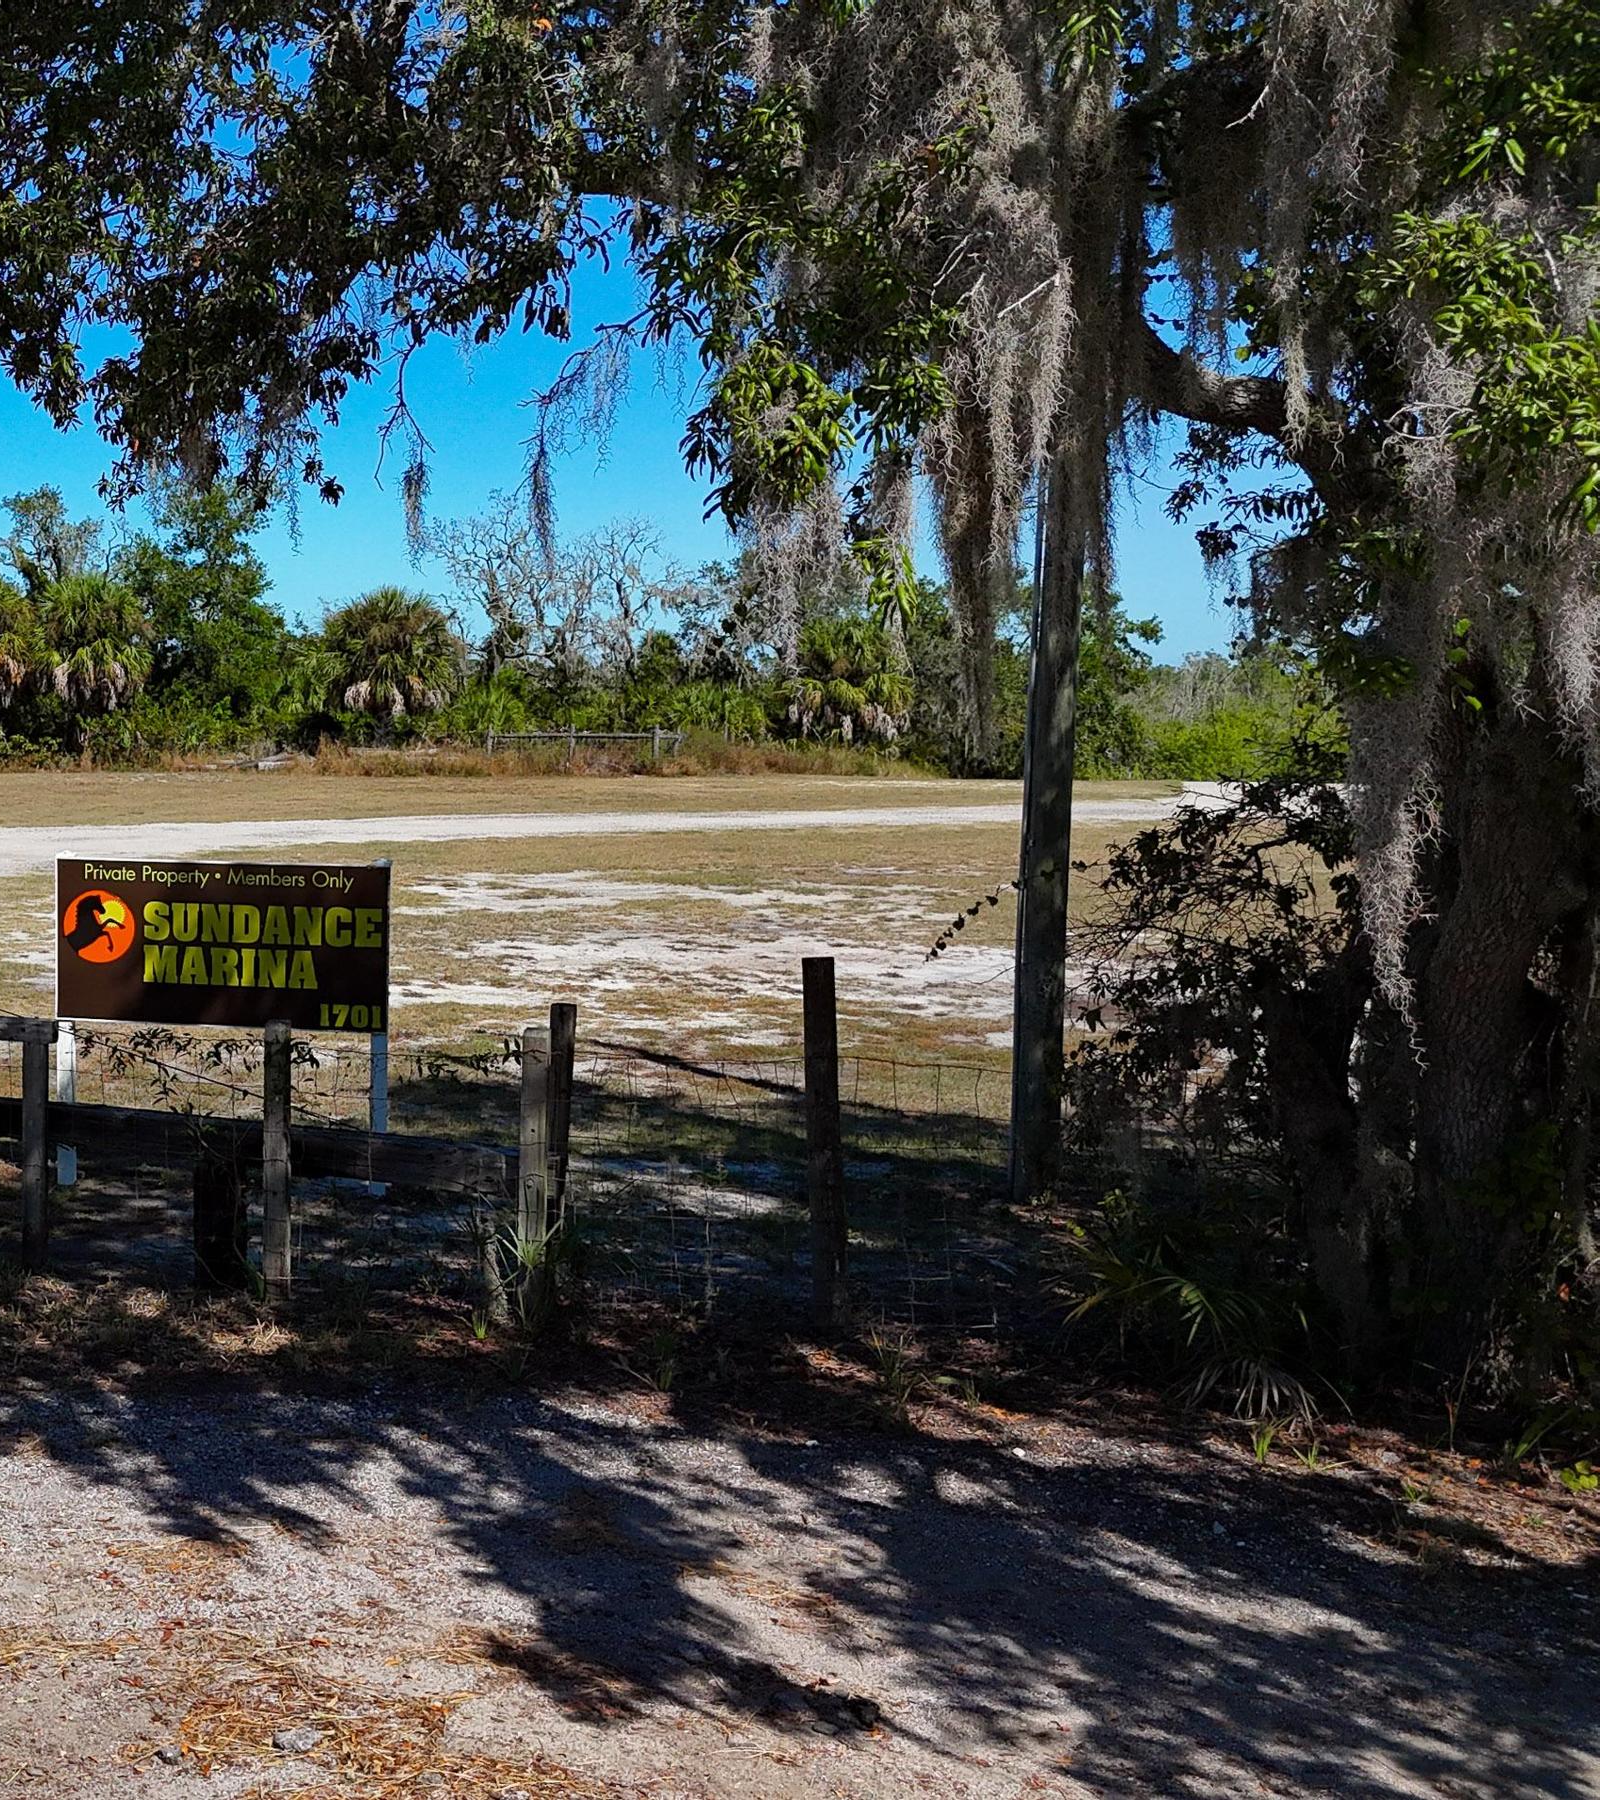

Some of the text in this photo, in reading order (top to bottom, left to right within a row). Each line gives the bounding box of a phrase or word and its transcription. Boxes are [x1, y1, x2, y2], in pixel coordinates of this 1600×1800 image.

[84, 863, 354, 893] Private Property Members Only
[143, 901, 383, 948] SUNDANCE
[143, 945, 318, 990] MARINA
[319, 1003, 382, 1029] 1701
